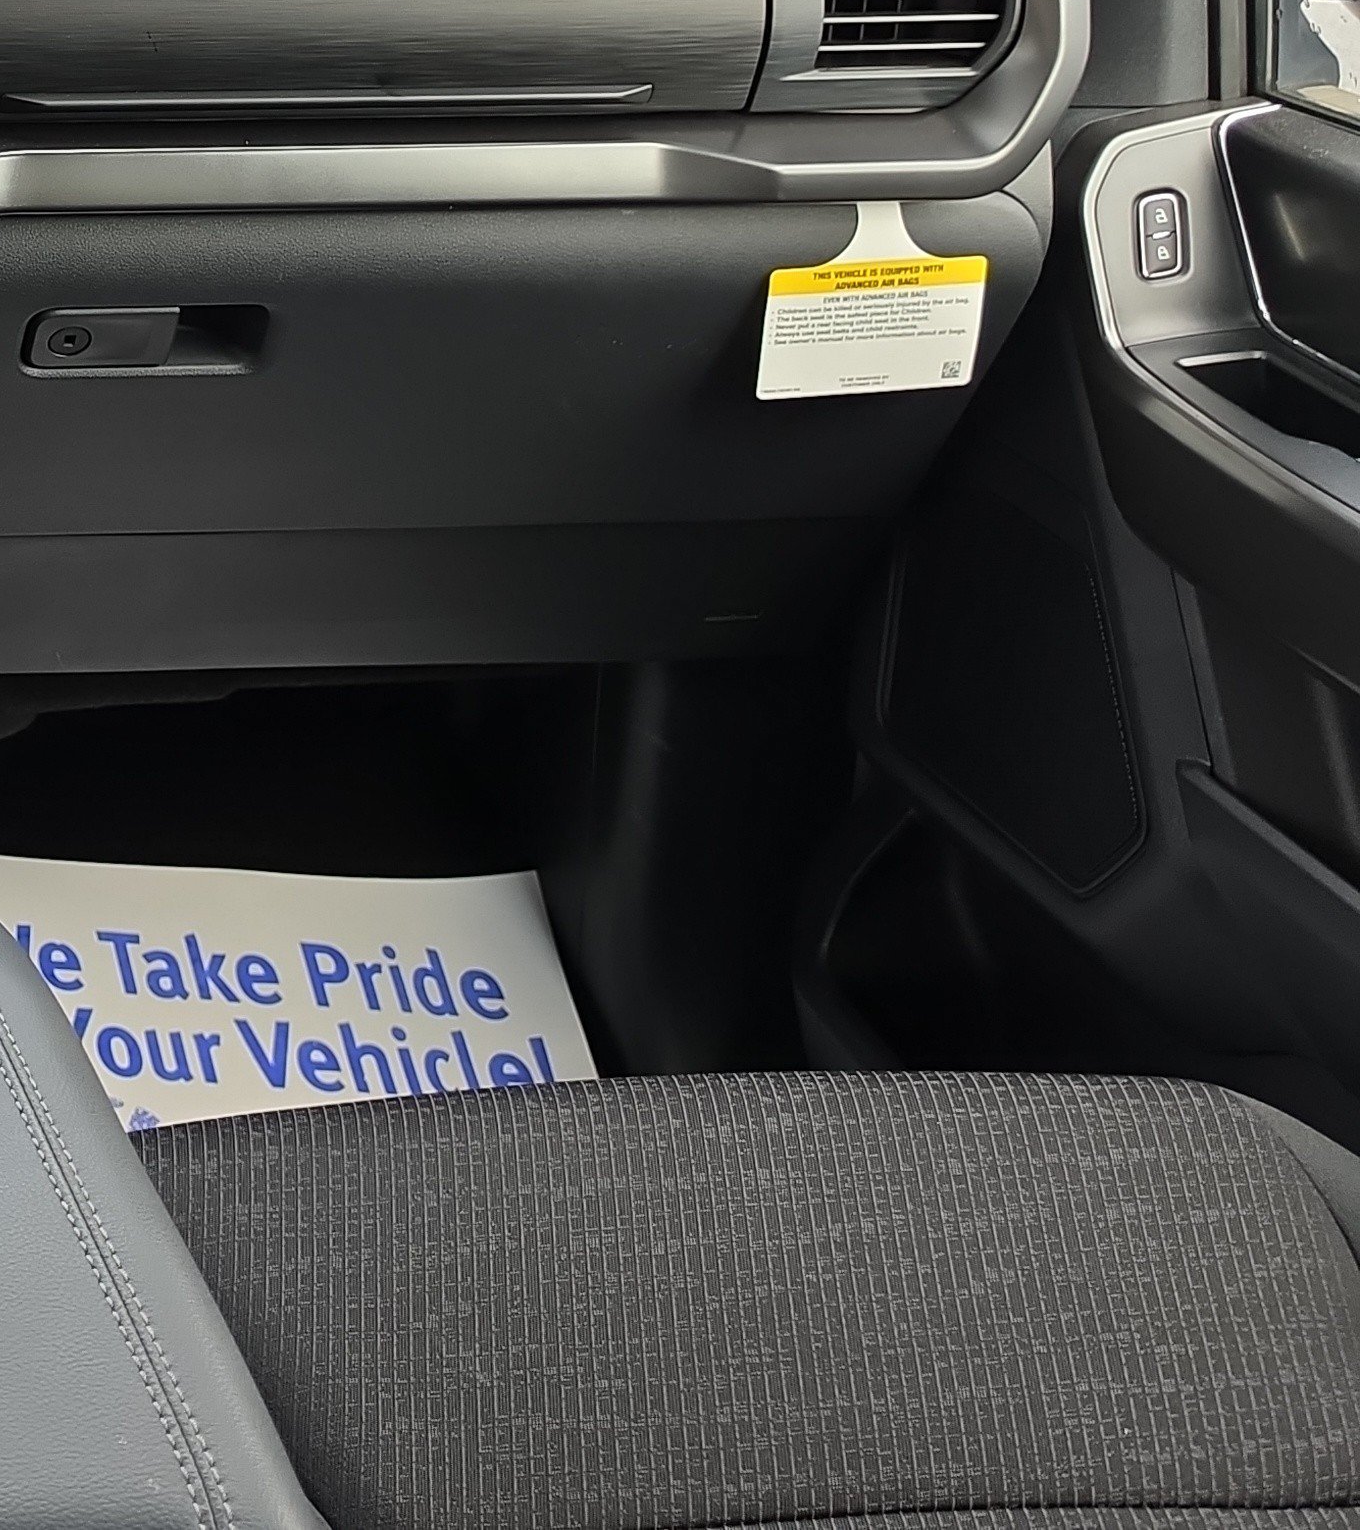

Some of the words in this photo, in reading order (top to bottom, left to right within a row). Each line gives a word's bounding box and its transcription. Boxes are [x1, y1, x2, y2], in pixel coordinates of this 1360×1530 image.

[813, 271, 832, 281] THIS
[834, 270, 867, 279] VEHICLE
[869, 268, 878, 277] IS
[880, 266, 920, 277] EQUIPPED
[922, 265, 944, 274] WITH
[834, 280, 879, 290] ADVANCED
[881, 278, 895, 287] AIR
[898, 277, 920, 286] BAGS
[823, 296, 840, 304] EVEN
[861, 293, 896, 302] ADVANCED
[911, 290, 928, 298] BAGS
[96, 930, 283, 1006] Take
[299, 940, 510, 1021] Pride
